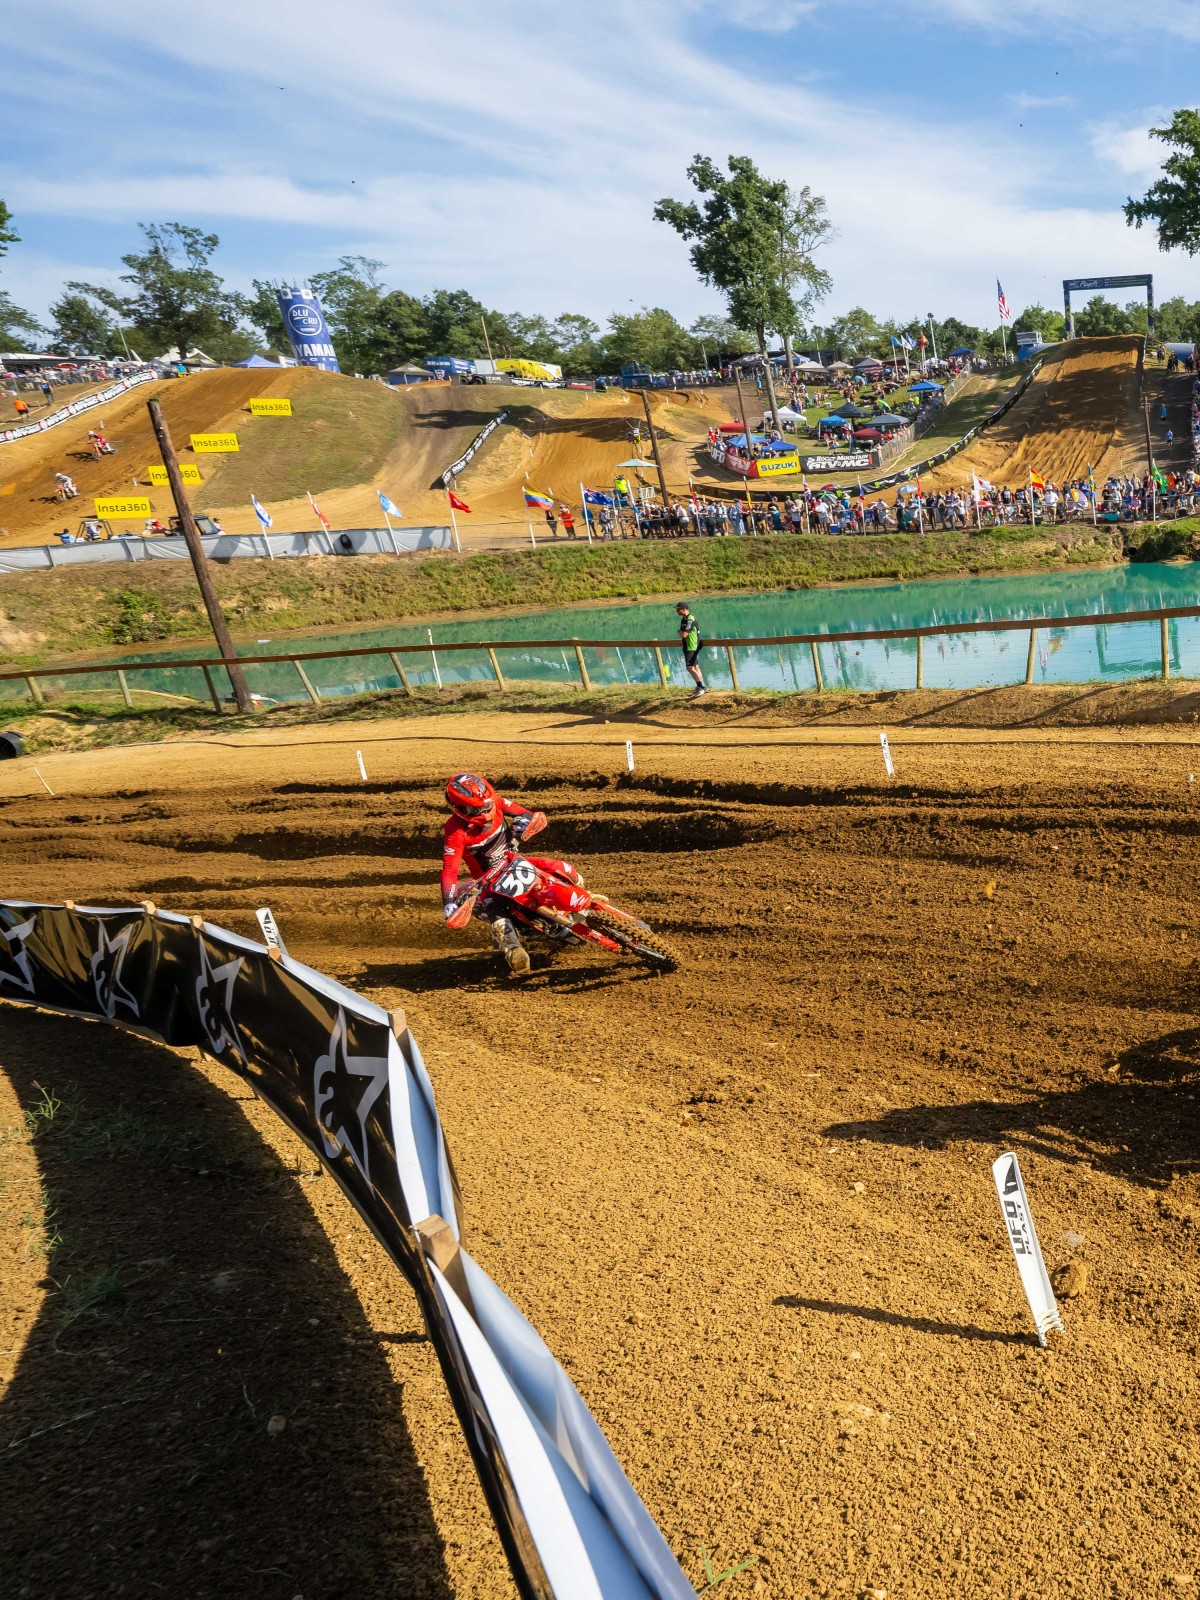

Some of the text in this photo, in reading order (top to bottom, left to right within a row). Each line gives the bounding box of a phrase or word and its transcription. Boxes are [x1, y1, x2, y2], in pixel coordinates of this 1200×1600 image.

[252, 402, 290, 411] Insta360
[193, 438, 236, 447] Insta360
[760, 461, 798, 472] SUZUKI
[151, 470, 197, 480] Ins360
[98, 502, 147, 512] Insta360
[502, 860, 536, 898] 30
[1004, 1200, 1027, 1255] UFO
